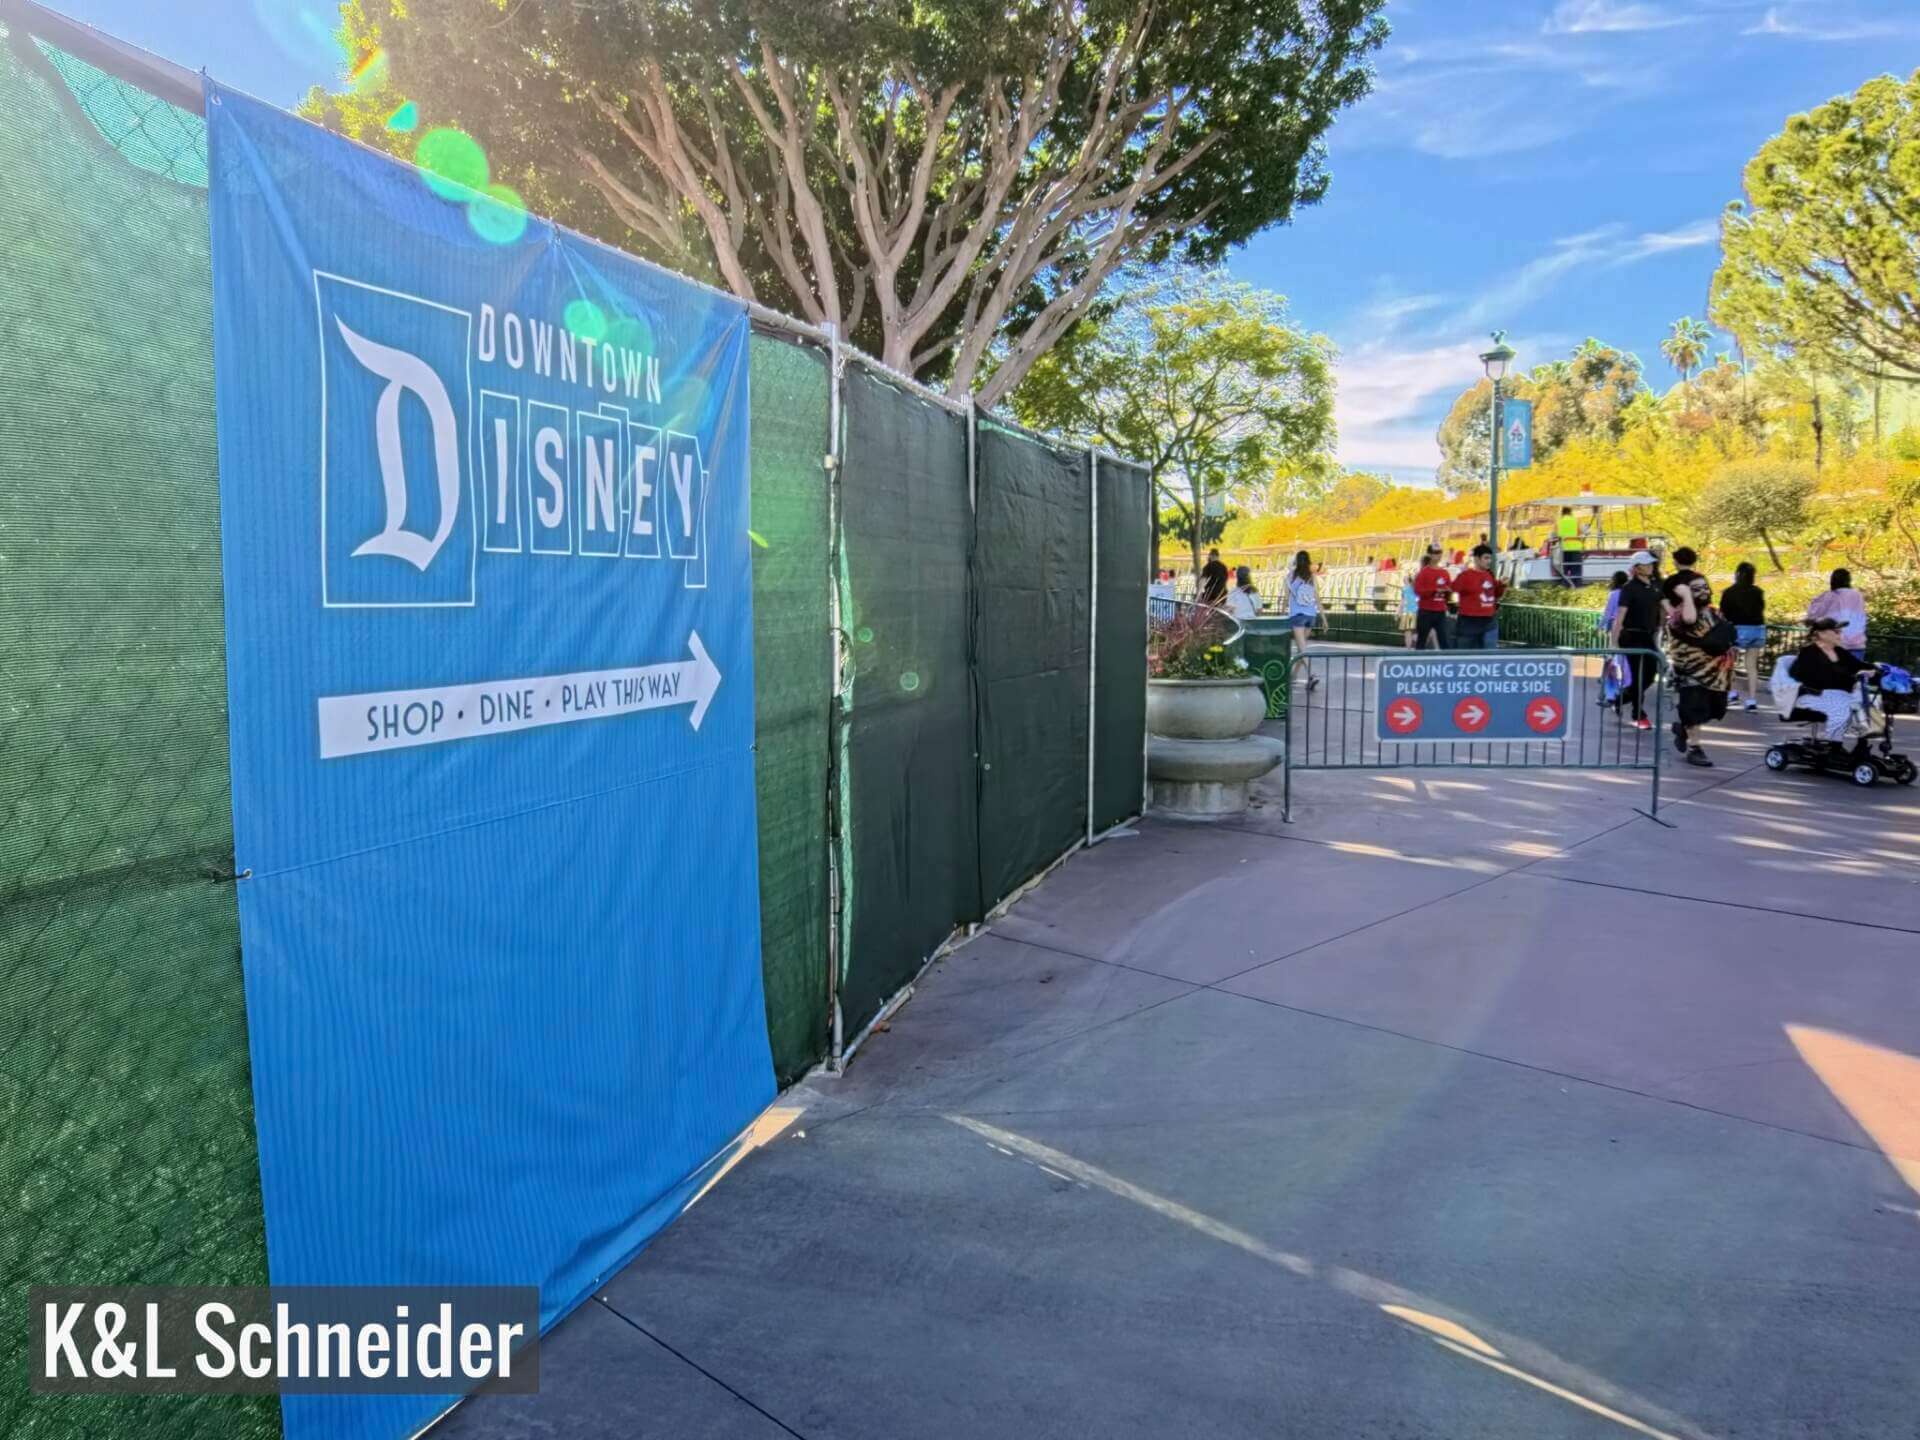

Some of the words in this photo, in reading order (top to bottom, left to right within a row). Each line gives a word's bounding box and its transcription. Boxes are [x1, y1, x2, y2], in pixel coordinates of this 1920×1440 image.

[478, 303, 661, 404] DOWNTOWN
[333, 313, 693, 572] DISNEY
[1383, 663, 1454, 679] LOADING
[1457, 662, 1501, 678] ZONE
[1504, 662, 1566, 677] CLOSED
[1396, 681, 1443, 694] PLEASE
[1447, 681, 1471, 694] USE
[1474, 680, 1519, 694] OTHER
[1522, 680, 1551, 693] SIDE
[367, 700, 444, 741] SHOP
[480, 689, 534, 725] DINE
[562, 681, 606, 713] PLAY
[612, 675, 646, 706] THIS
[648, 671, 681, 699] WAY
